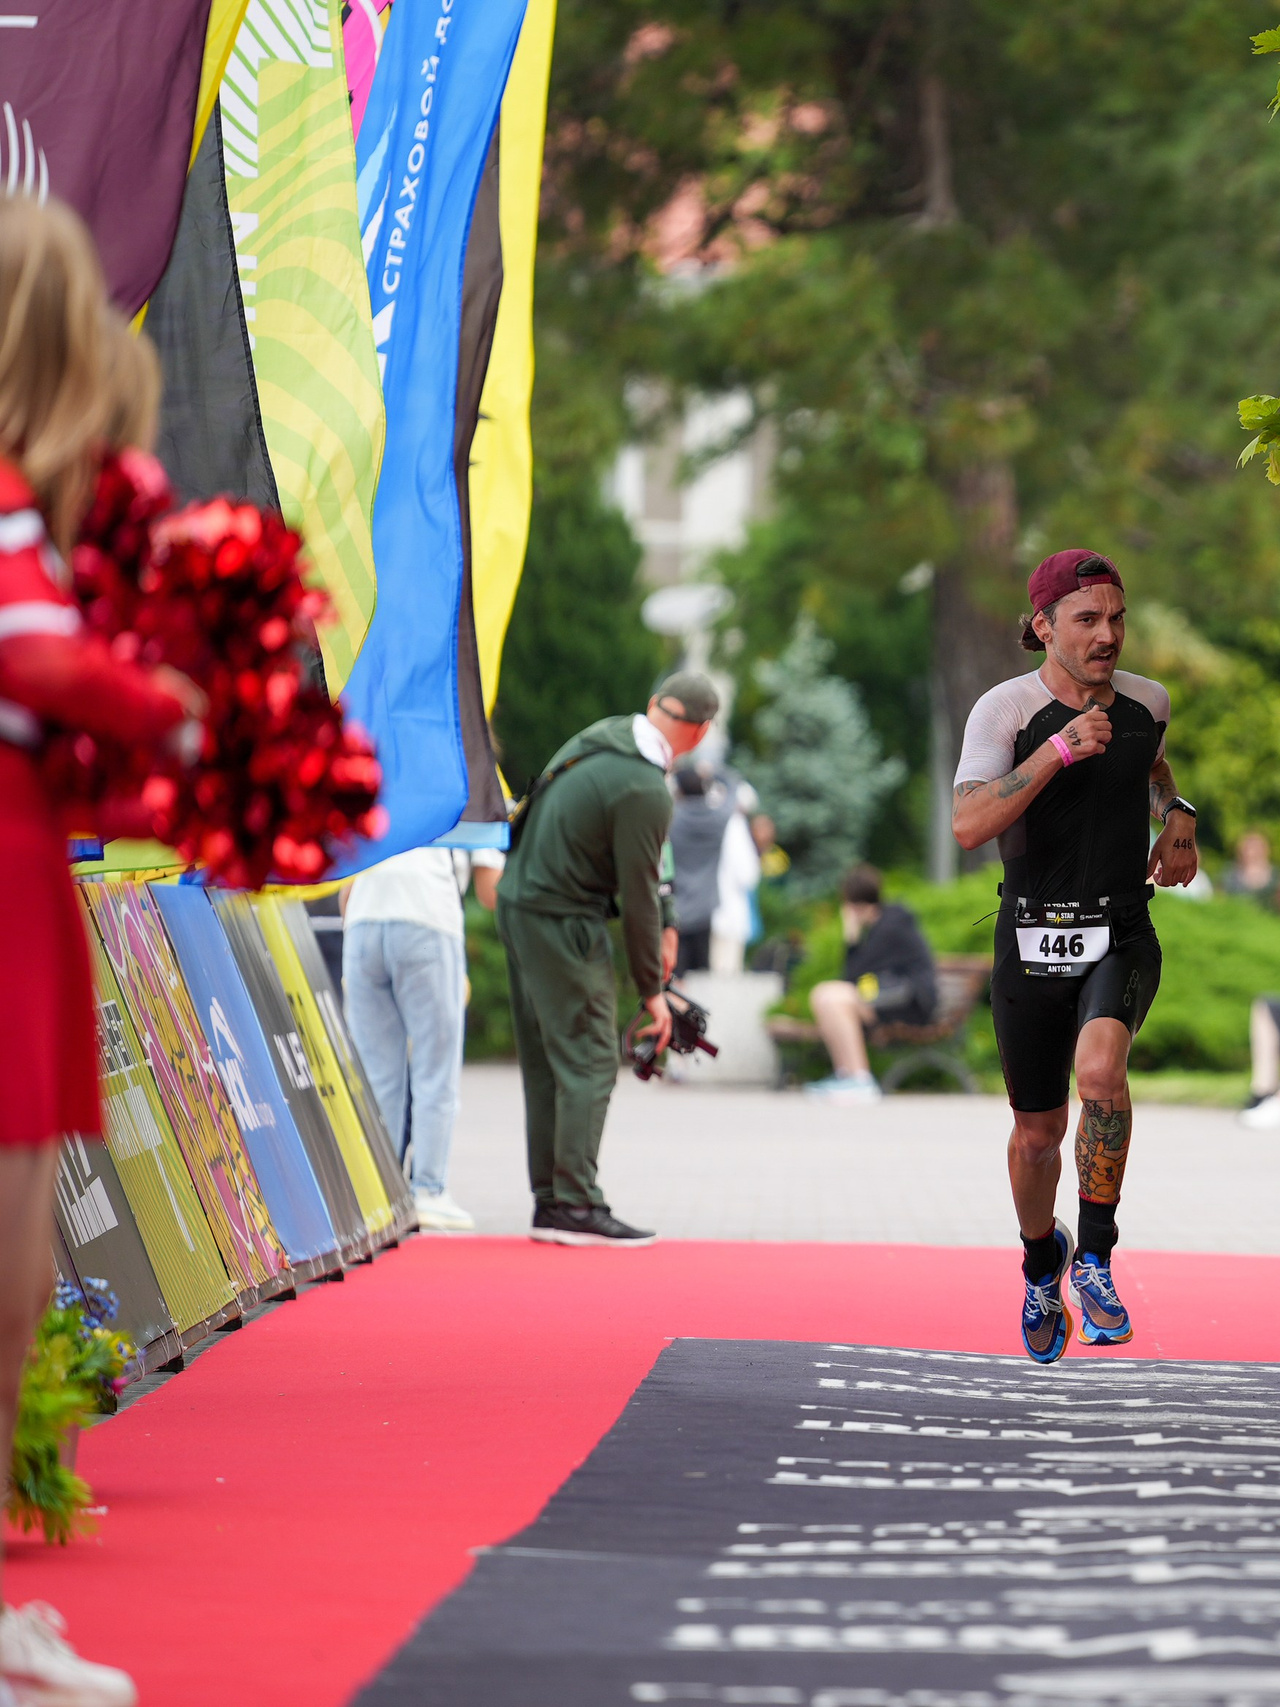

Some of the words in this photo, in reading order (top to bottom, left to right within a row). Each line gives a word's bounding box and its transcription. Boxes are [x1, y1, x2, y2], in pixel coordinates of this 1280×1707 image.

[382, 55, 440, 295] СТРАХОВОЙ
[1065, 725, 1082, 746] 446
[1173, 838, 1193, 850] 446
[1039, 933, 1084, 958] 446
